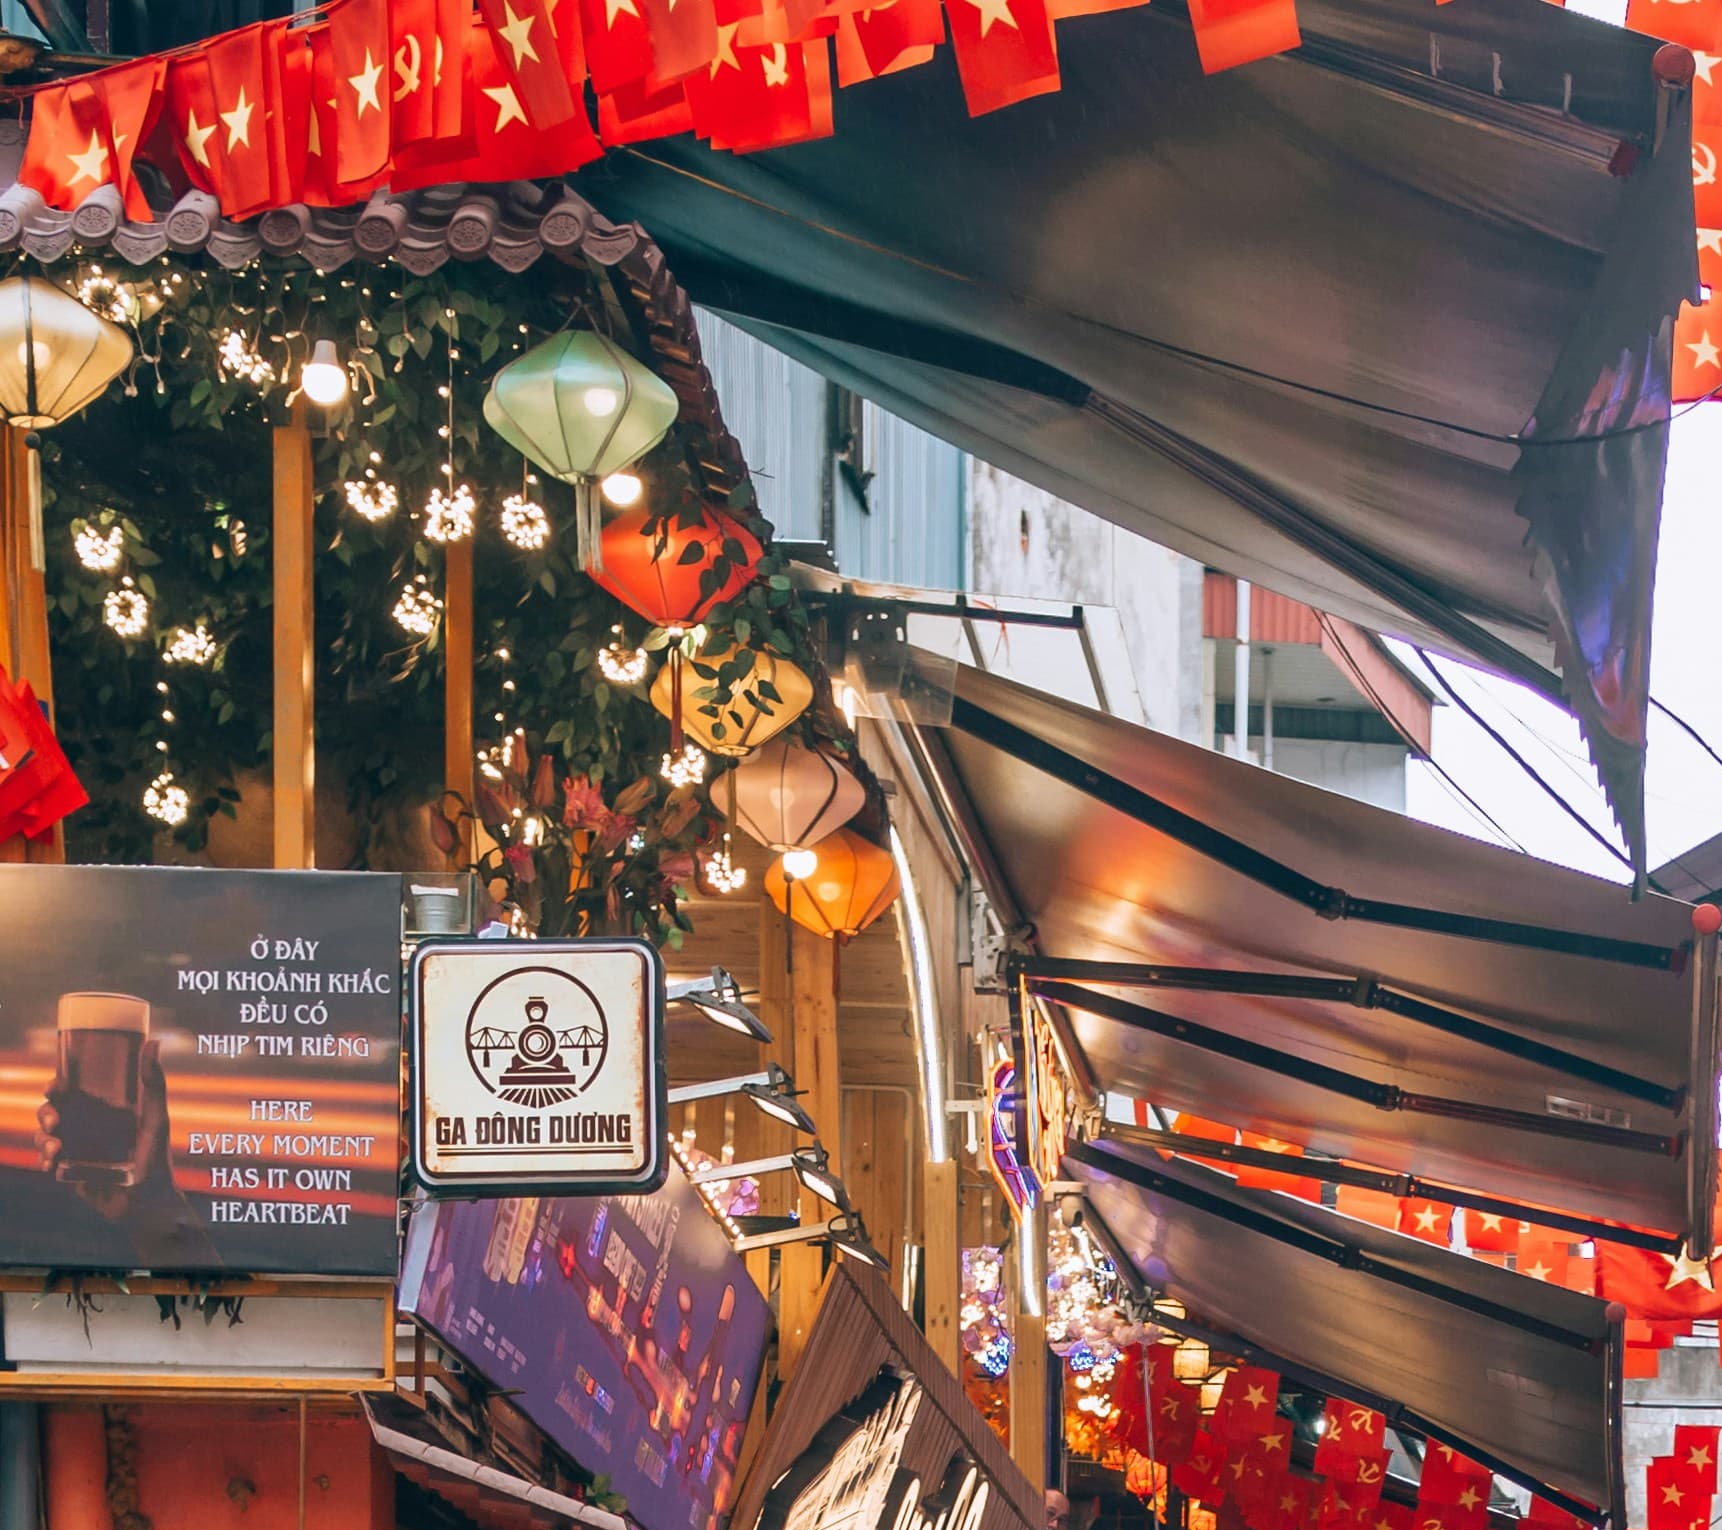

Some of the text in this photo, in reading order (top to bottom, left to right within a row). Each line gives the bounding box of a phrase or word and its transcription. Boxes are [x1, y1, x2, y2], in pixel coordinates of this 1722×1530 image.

[250, 934, 320, 961] Ở ĐÂY
[177, 966, 391, 995] MỌI KHOẢNH KHẮC
[240, 996, 328, 1025] ĐỀU CÓ
[198, 1034, 369, 1058] NHỊP TIM RIÊNG
[250, 1100, 313, 1121] HERE
[435, 1111, 631, 1145] GA ĐÔNG DƯƠNG
[189, 1133, 374, 1157] EVERY MOMENT
[211, 1168, 351, 1191] HAS IT OWN
[211, 1201, 351, 1225] HEARTBEAT
